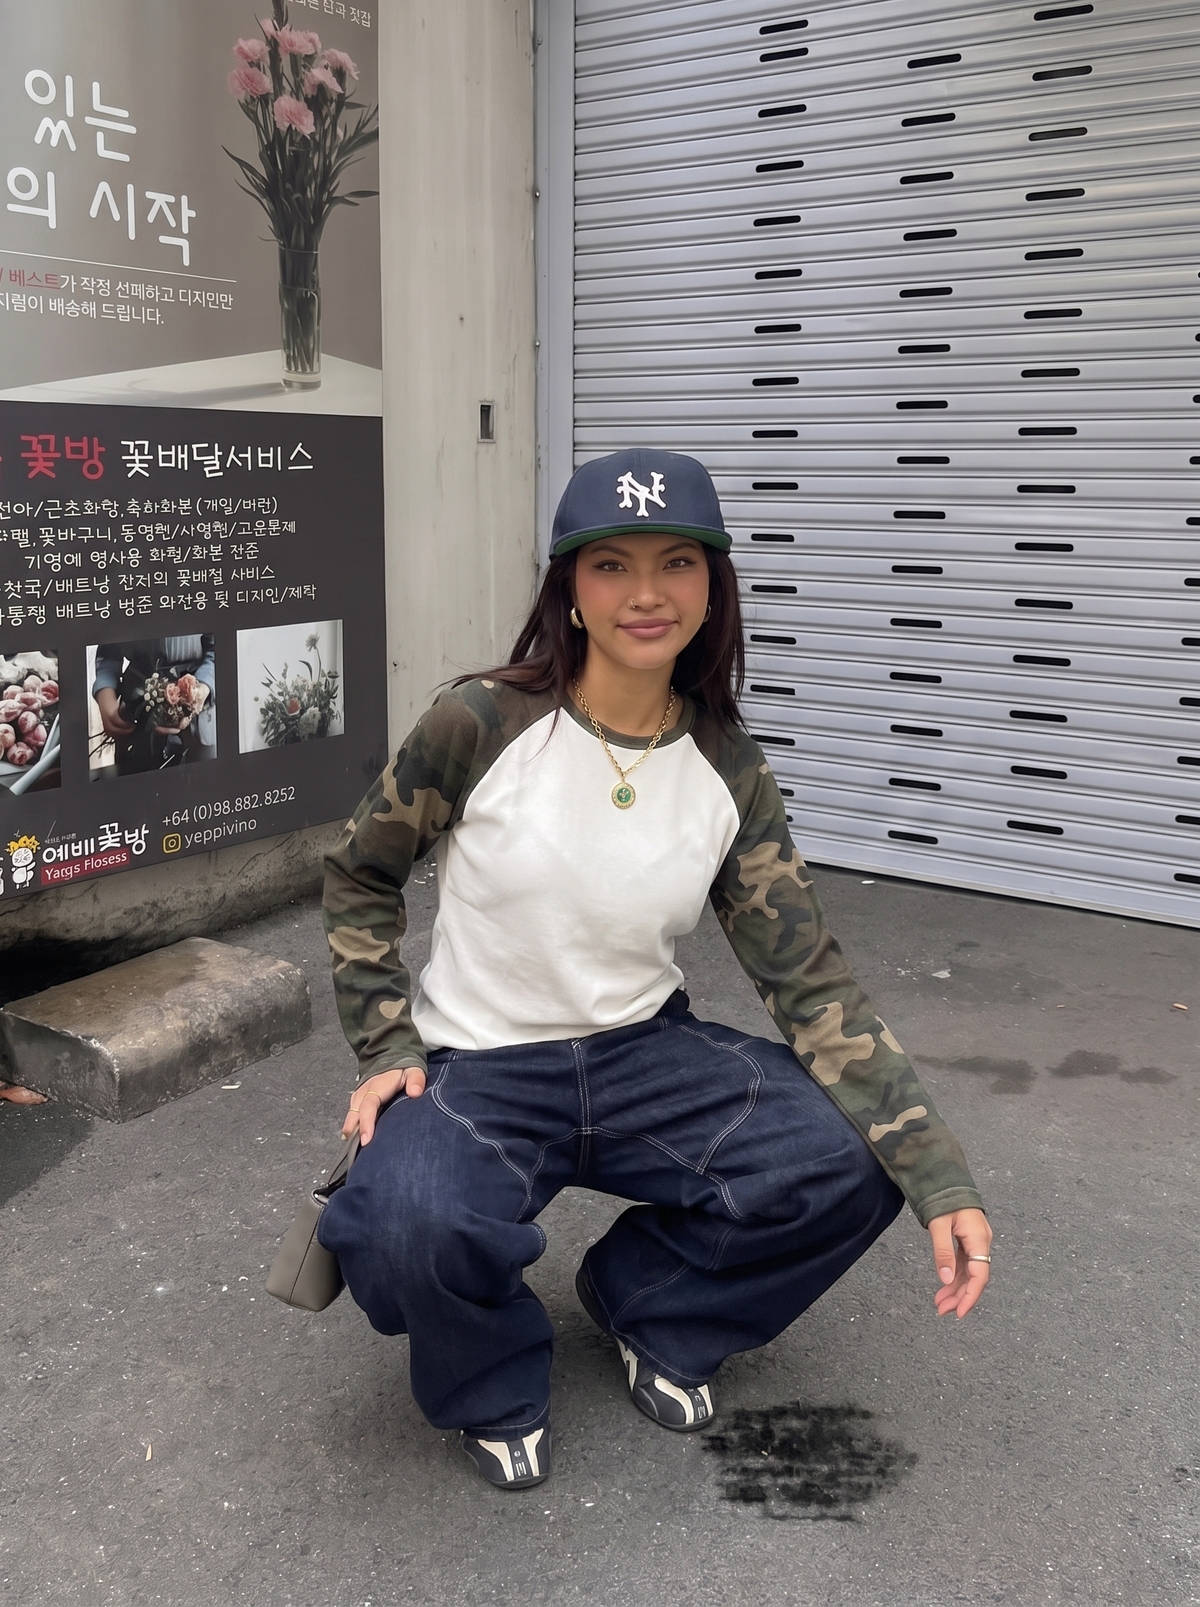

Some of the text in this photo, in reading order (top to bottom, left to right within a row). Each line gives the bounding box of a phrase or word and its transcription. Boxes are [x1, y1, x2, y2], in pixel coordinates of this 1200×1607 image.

[24, 69, 137, 163] 있는
[6, 166, 197, 267] 의 시작
[48, 297, 97, 319] 배송해
[100, 302, 165, 326] 드립니다.
[20, 434, 314, 480] 꽃방 꽃배달서비스
[55, 600, 111, 620] 배트낭
[162, 808, 190, 827] +64
[184, 819, 257, 849] yeppivino
[84, 852, 128, 871] Flosess
